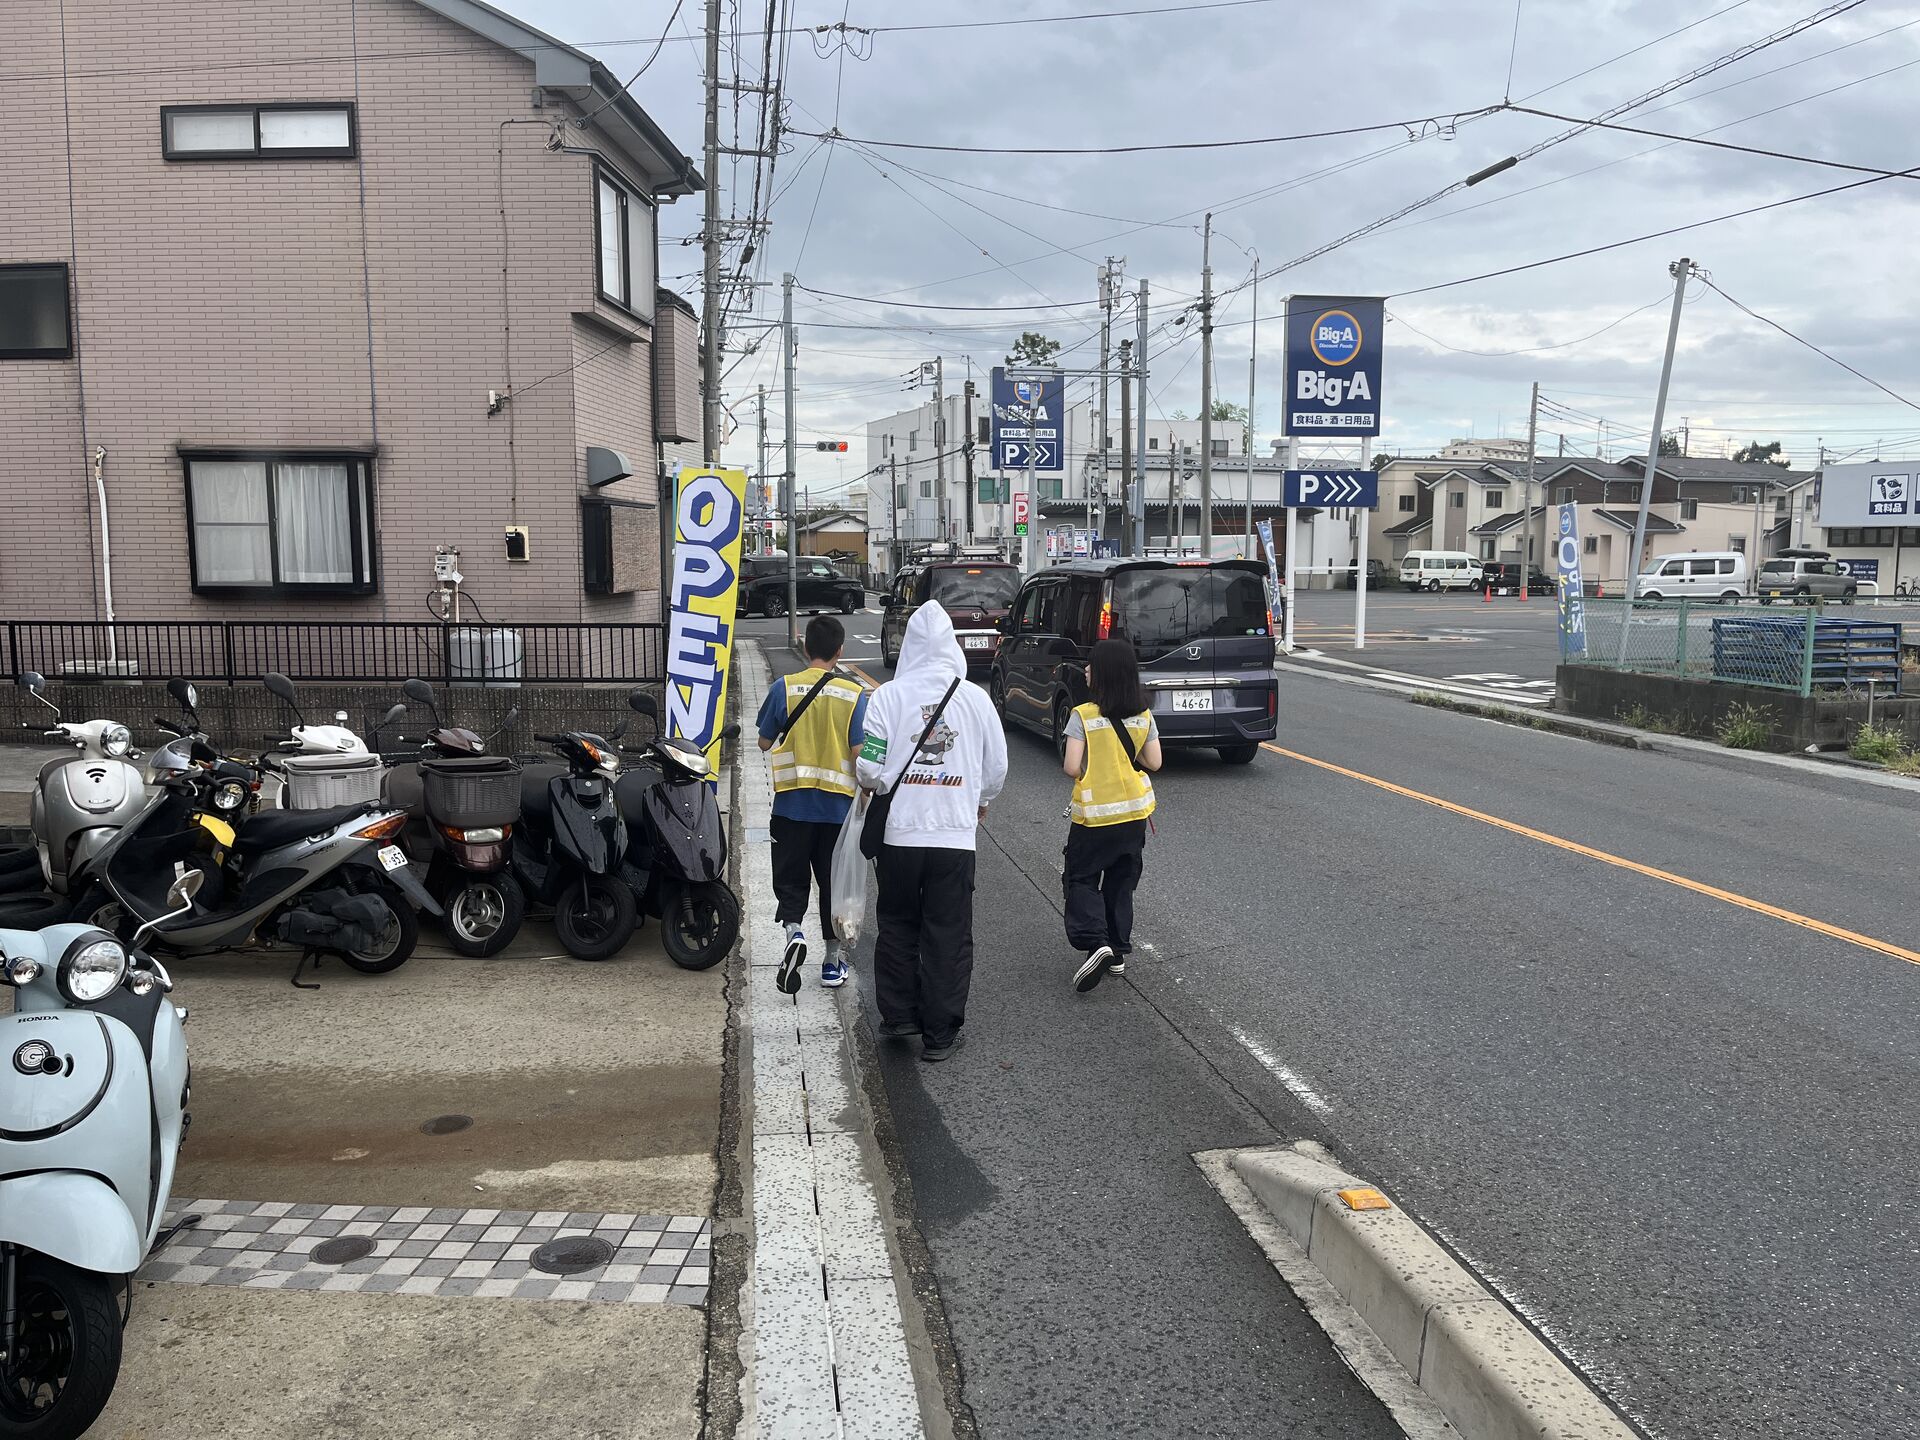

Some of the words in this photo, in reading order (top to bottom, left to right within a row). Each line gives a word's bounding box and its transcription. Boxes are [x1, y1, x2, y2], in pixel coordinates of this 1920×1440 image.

[1319, 327, 1353, 343] Big-A
[1297, 370, 1371, 406] Big-A
[1296, 414, 1371, 425] 食料品・酒・日用品
[1005, 444, 1020, 464] P
[1299, 474, 1320, 503] P
[1016, 501, 1029, 523] P
[1874, 503, 1902, 513] 食料品
[665, 476, 742, 748] OPEN
[1181, 698, 1211, 710] 46-67
[898, 771, 963, 787] ama-fun
[17, 1015, 59, 1024] HONDA
